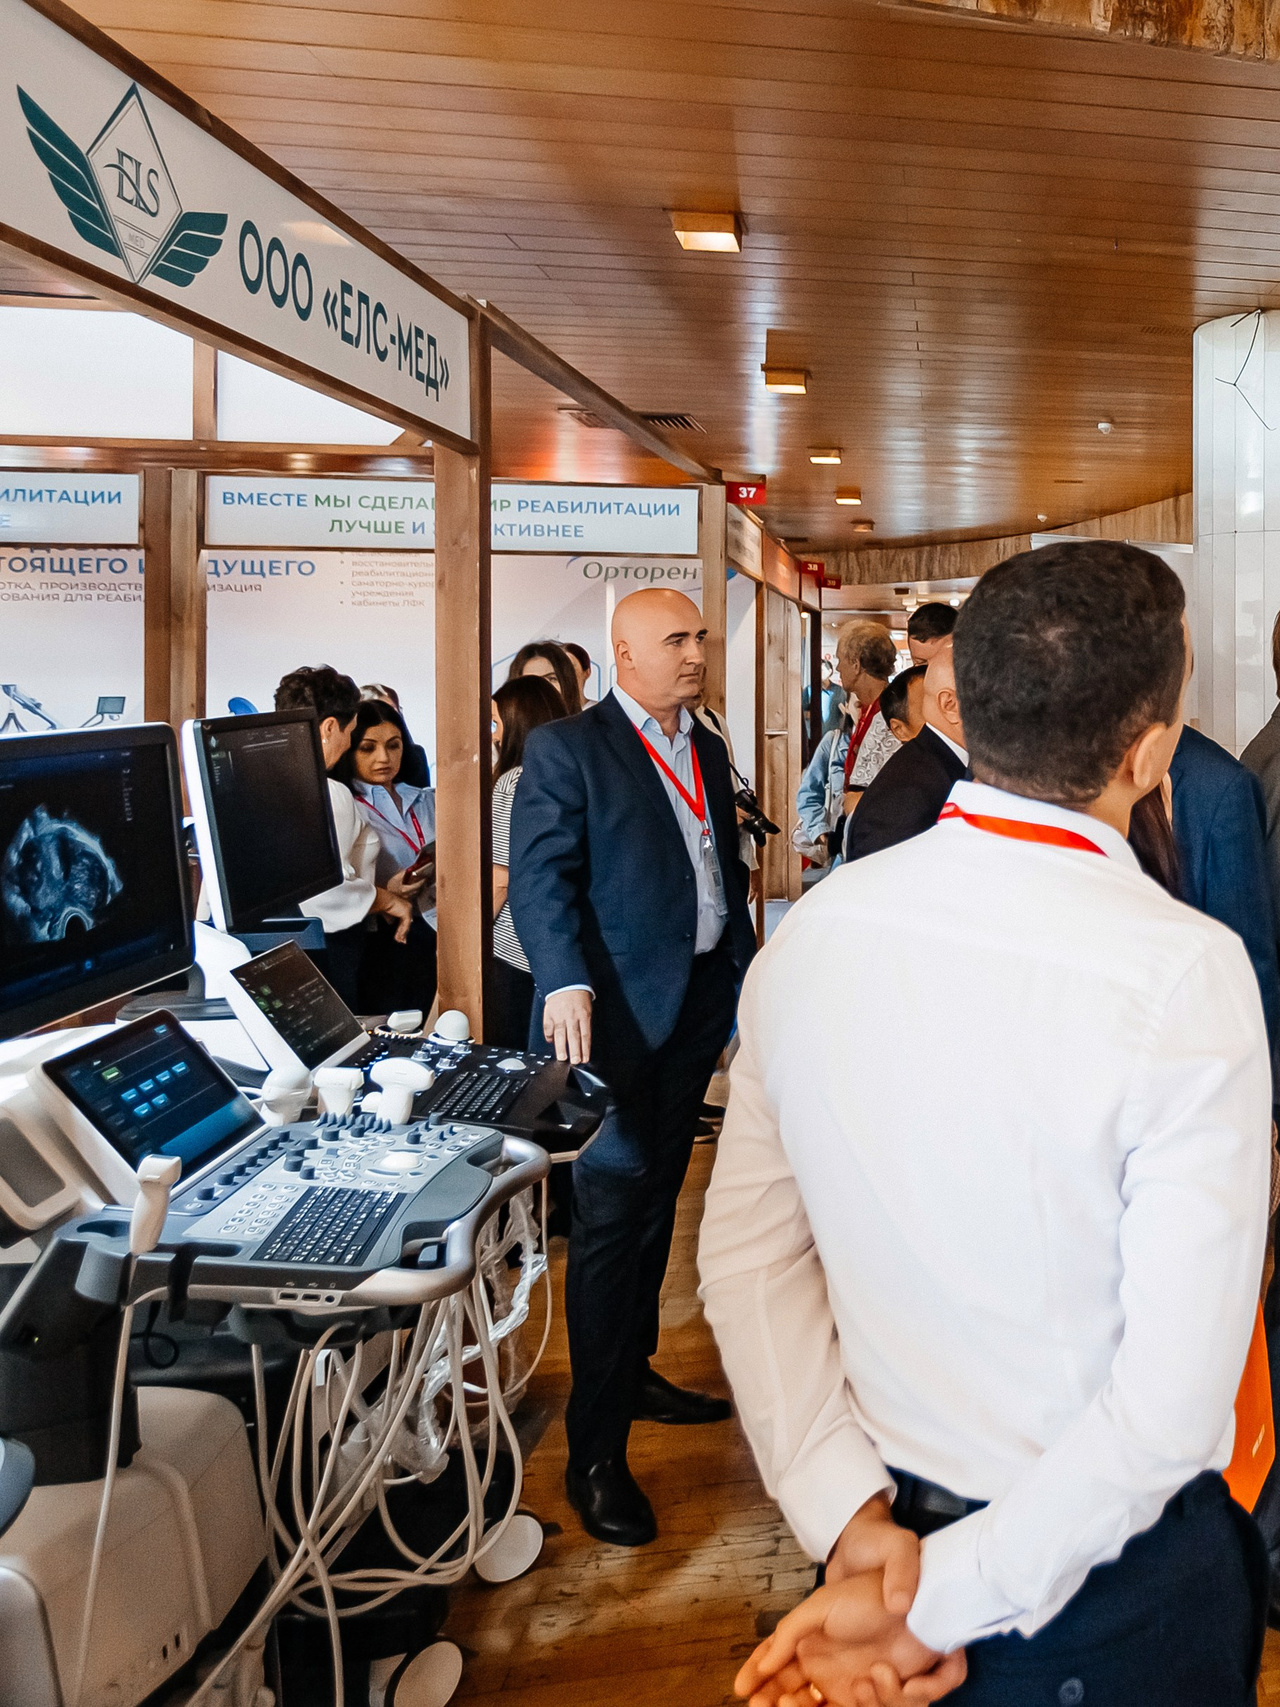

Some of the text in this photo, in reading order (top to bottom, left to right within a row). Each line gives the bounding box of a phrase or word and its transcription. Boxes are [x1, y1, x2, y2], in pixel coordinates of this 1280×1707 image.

[239, 220, 449, 402] ООО «ЕЛС-МЕД»
[739, 487, 756, 498] 37
[222, 491, 308, 508] ВМЕСТЕ
[314, 493, 351, 509] МЫ
[517, 499, 681, 518] РЕАБИЛИТАЦИИ
[329, 518, 405, 535] ЛУЧШЕ
[412, 521, 425, 535] И
[807, 563, 818, 571] 38
[63, 593, 96, 603] ДЛЯ
